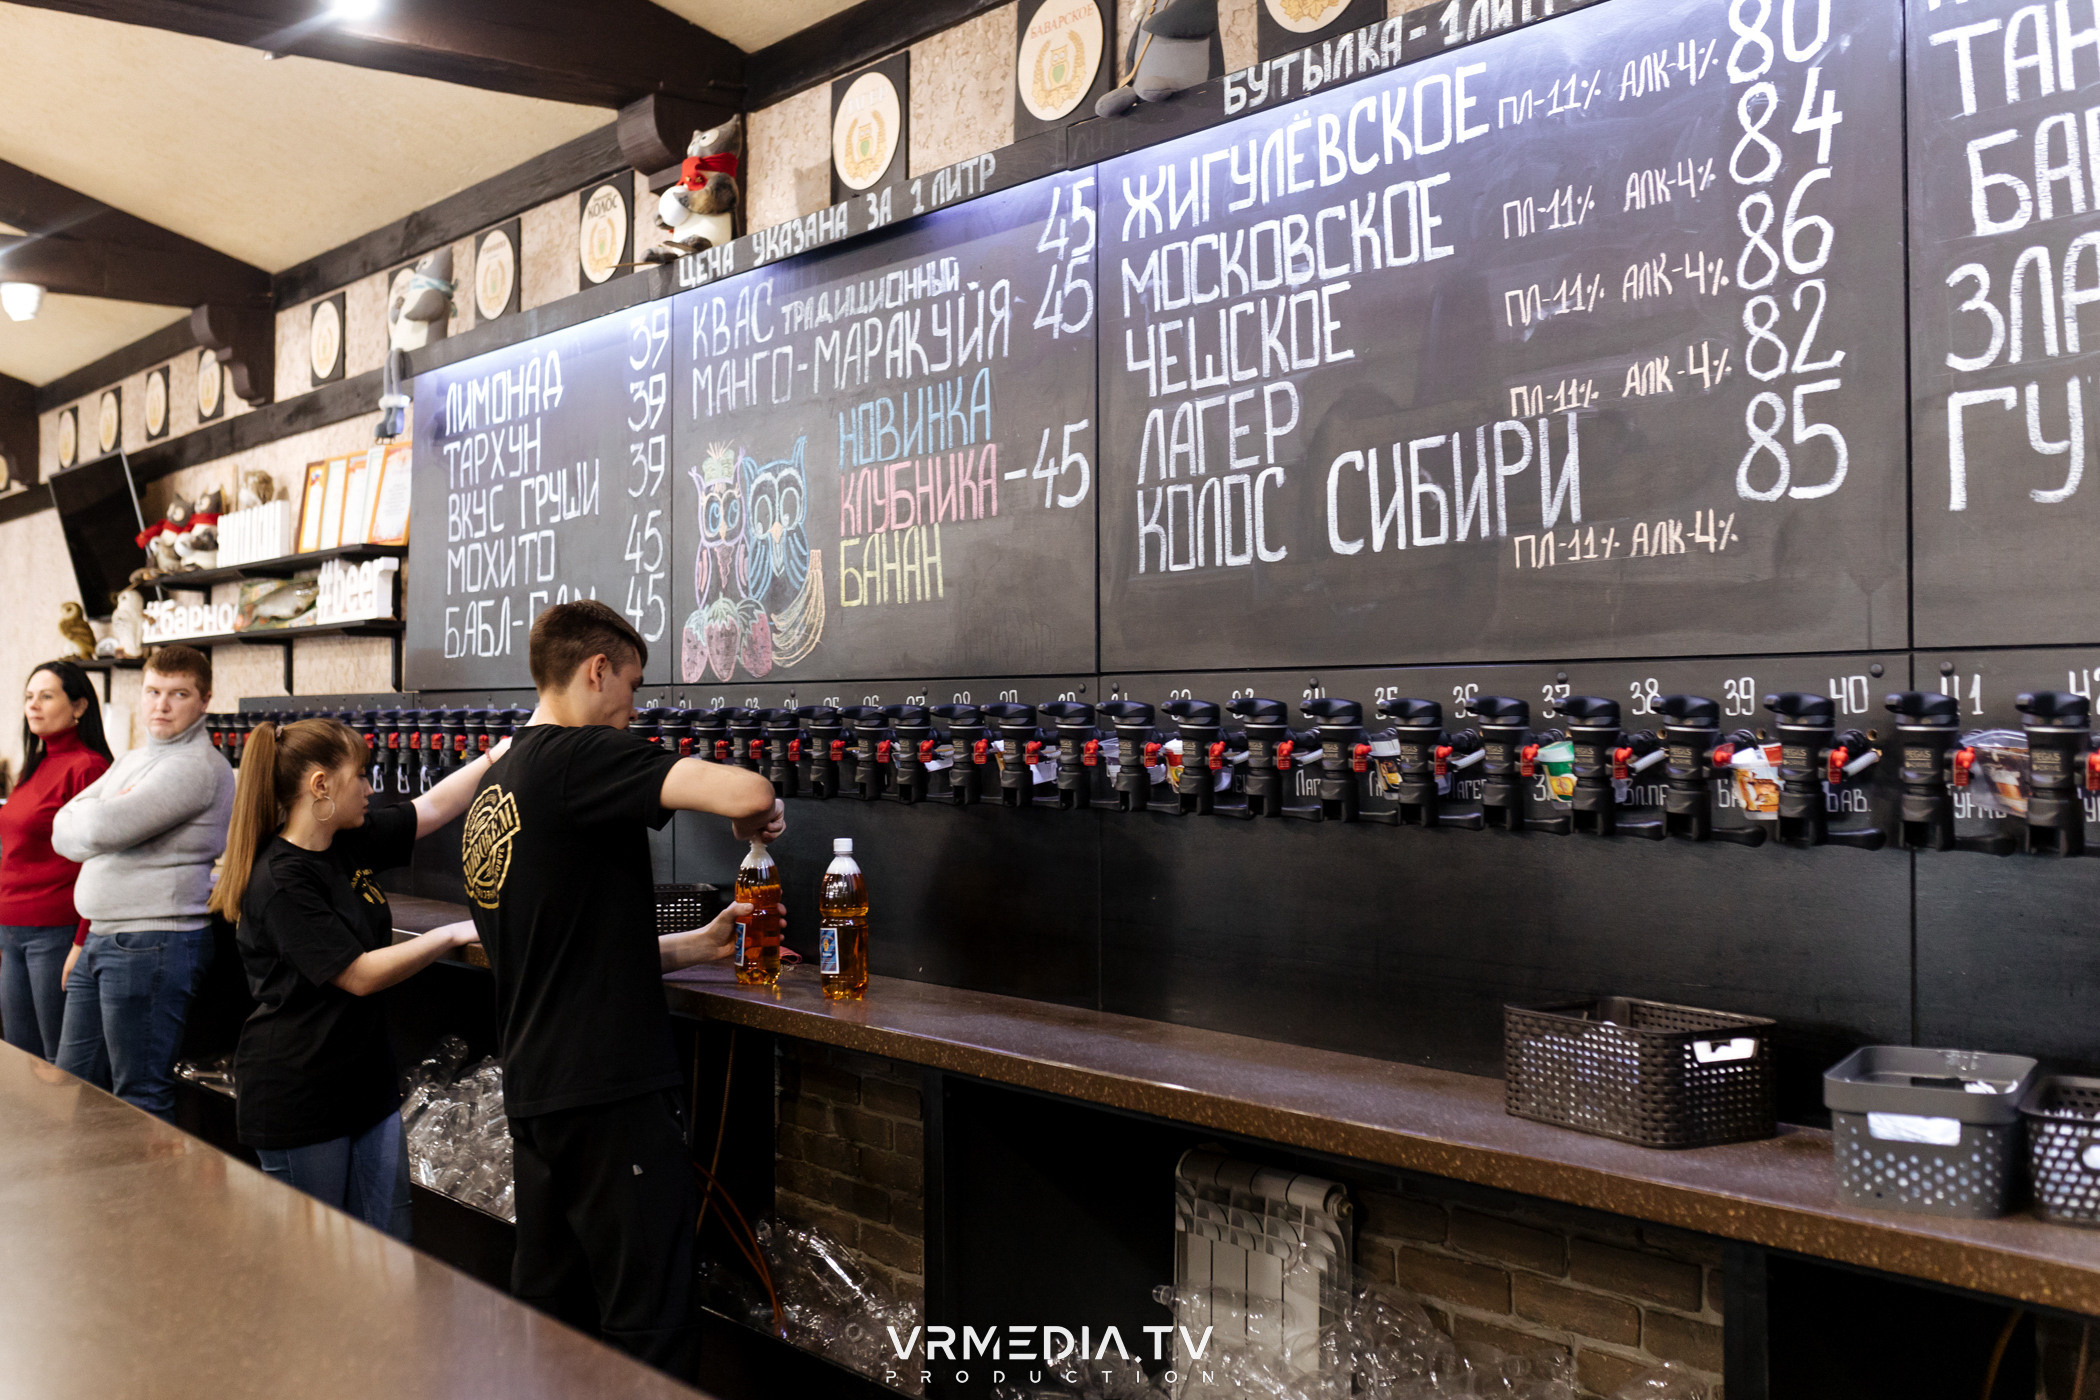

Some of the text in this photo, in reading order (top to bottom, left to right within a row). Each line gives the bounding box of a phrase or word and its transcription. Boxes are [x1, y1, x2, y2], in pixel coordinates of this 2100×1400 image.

[1122, 62, 1490, 242] ЖИГУЛЁВСКОЕ
[1727, 0, 1831, 84] 80
[679, 248, 734, 288] ЦЕНА
[752, 201, 848, 266] УКАЗАНА
[867, 186, 892, 230] ЗА
[1122, 172, 1454, 318] МОСКОВСКОЕ
[1729, 67, 1843, 185] 84
[693, 277, 774, 360] КВАС
[1036, 176, 1095, 260] 45
[1034, 254, 1094, 339] 45
[1125, 282, 1354, 397] ЧЕШСКОЕ
[1736, 167, 1834, 290] 86
[446, 306, 669, 435] ЛИМОНАД 39
[838, 367, 990, 470] НОВИНКА
[1137, 381, 1300, 485] ЛАГЕР
[1742, 278, 1846, 382] 82
[443, 373, 667, 489] ТАРХУН 39
[1137, 466, 1288, 574] КОЛОС
[1327, 412, 1582, 555] СИБИРИ
[1736, 378, 1848, 502] 85
[447, 487, 505, 543] ВКУС
[520, 458, 600, 530] ГРУШИ
[628, 435, 666, 498] 39
[447, 510, 663, 595] МОХИТО 45
[840, 522, 944, 607] БАНАН
[625, 572, 665, 642] 45
[1724, 677, 1755, 716] 39
[1830, 676, 1868, 714] 40
